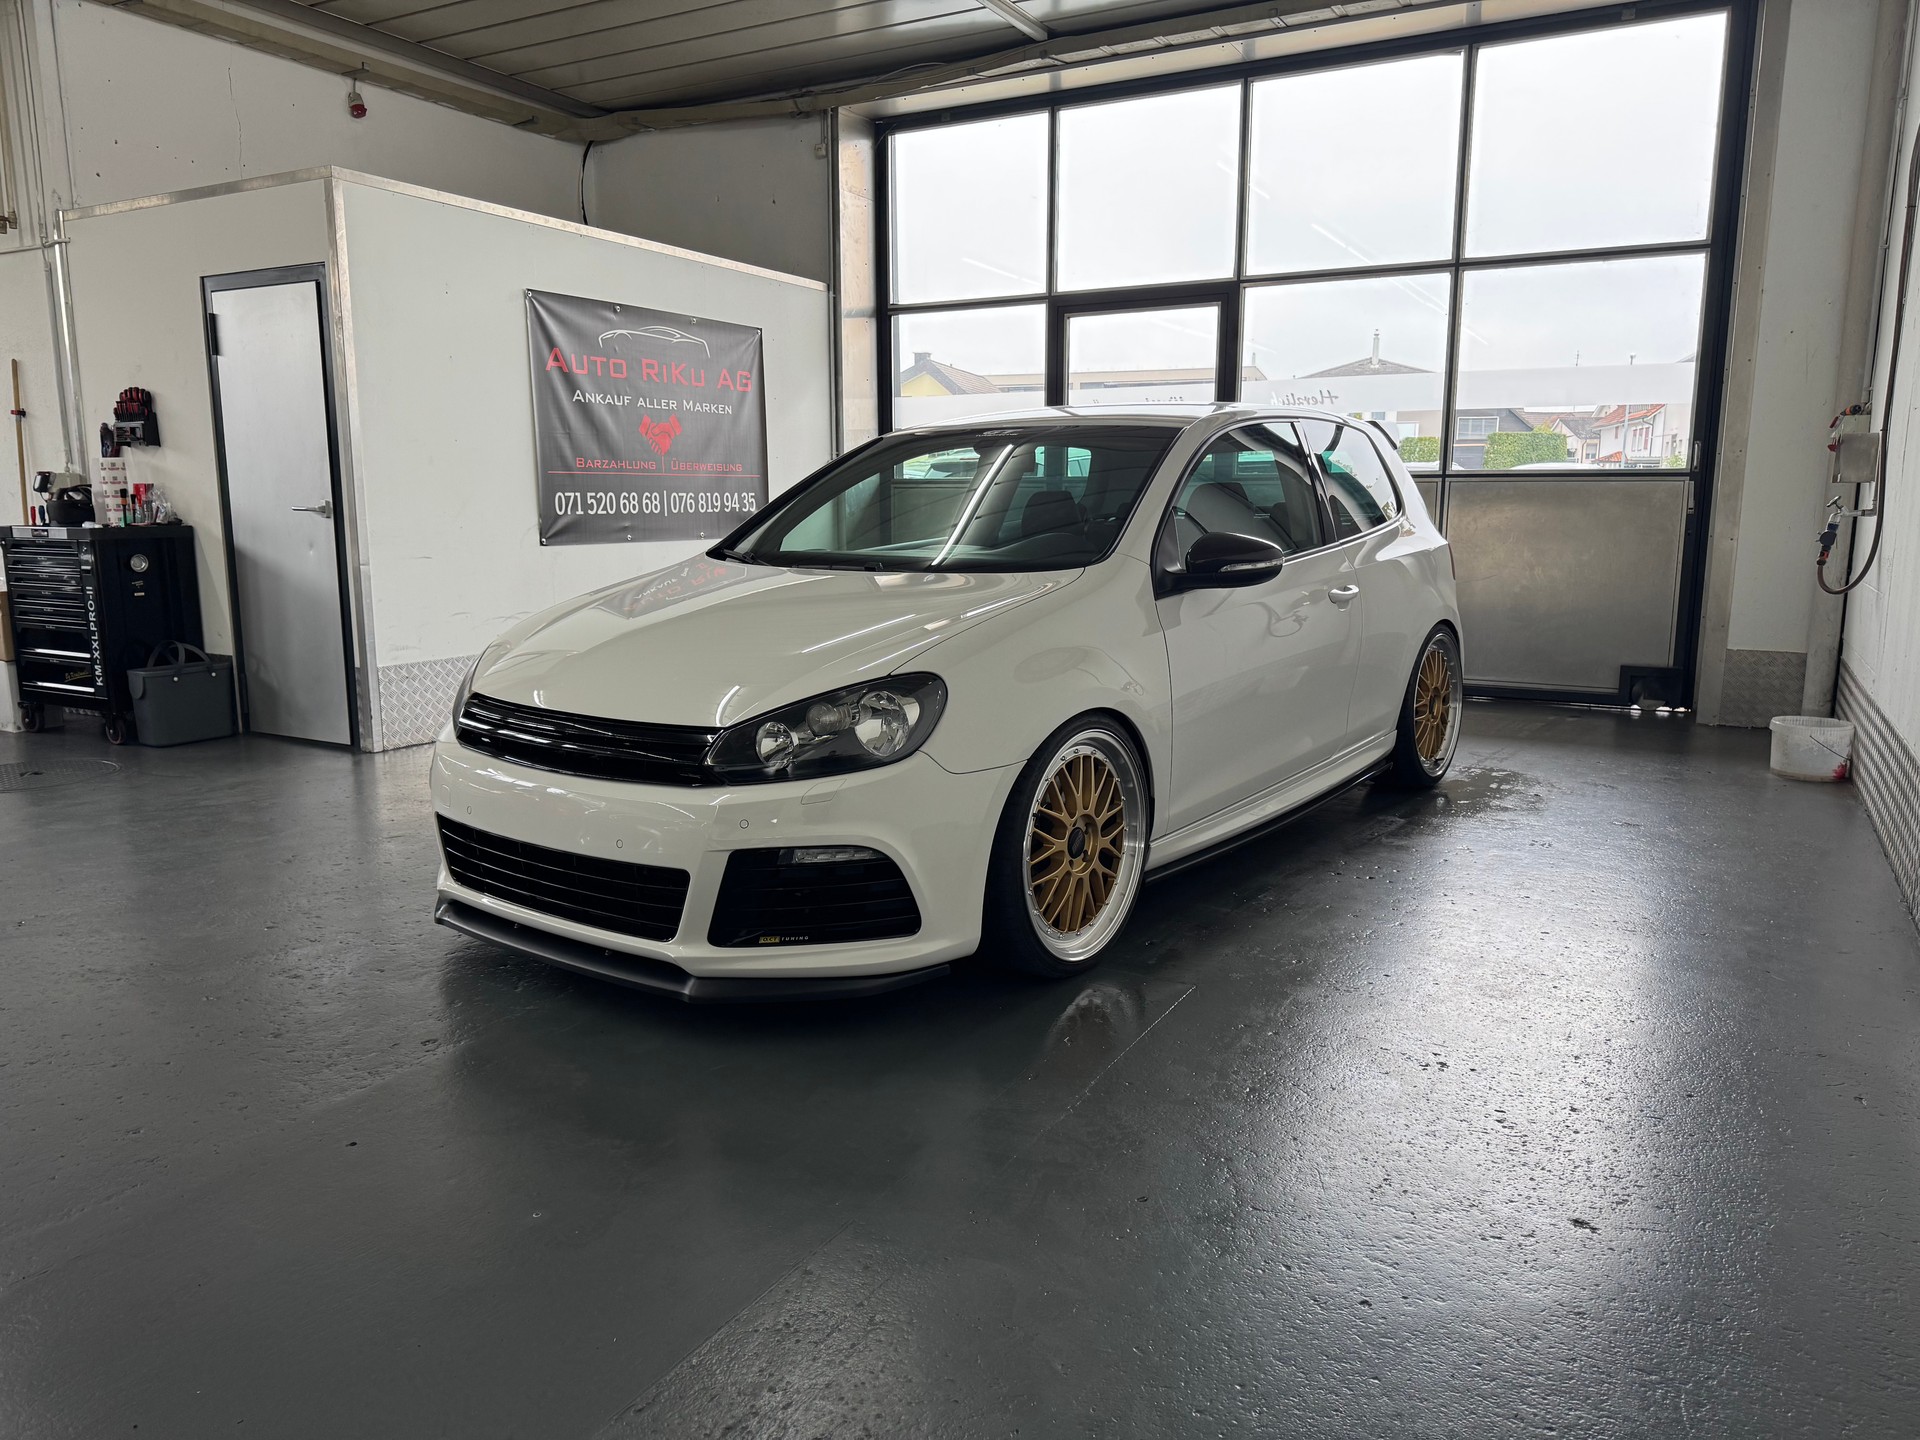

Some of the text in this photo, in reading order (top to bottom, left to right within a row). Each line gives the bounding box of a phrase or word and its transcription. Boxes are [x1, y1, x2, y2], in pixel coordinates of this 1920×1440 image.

[717, 368, 752, 393] AG
[554, 491, 584, 515] 071
[587, 491, 617, 515] 520
[619, 491, 639, 514] 68
[642, 491, 661, 514] 68
[670, 491, 695, 514] 076
[698, 492, 721, 513] 819
[723, 492, 740, 513] 94
[742, 492, 757, 512] 35
